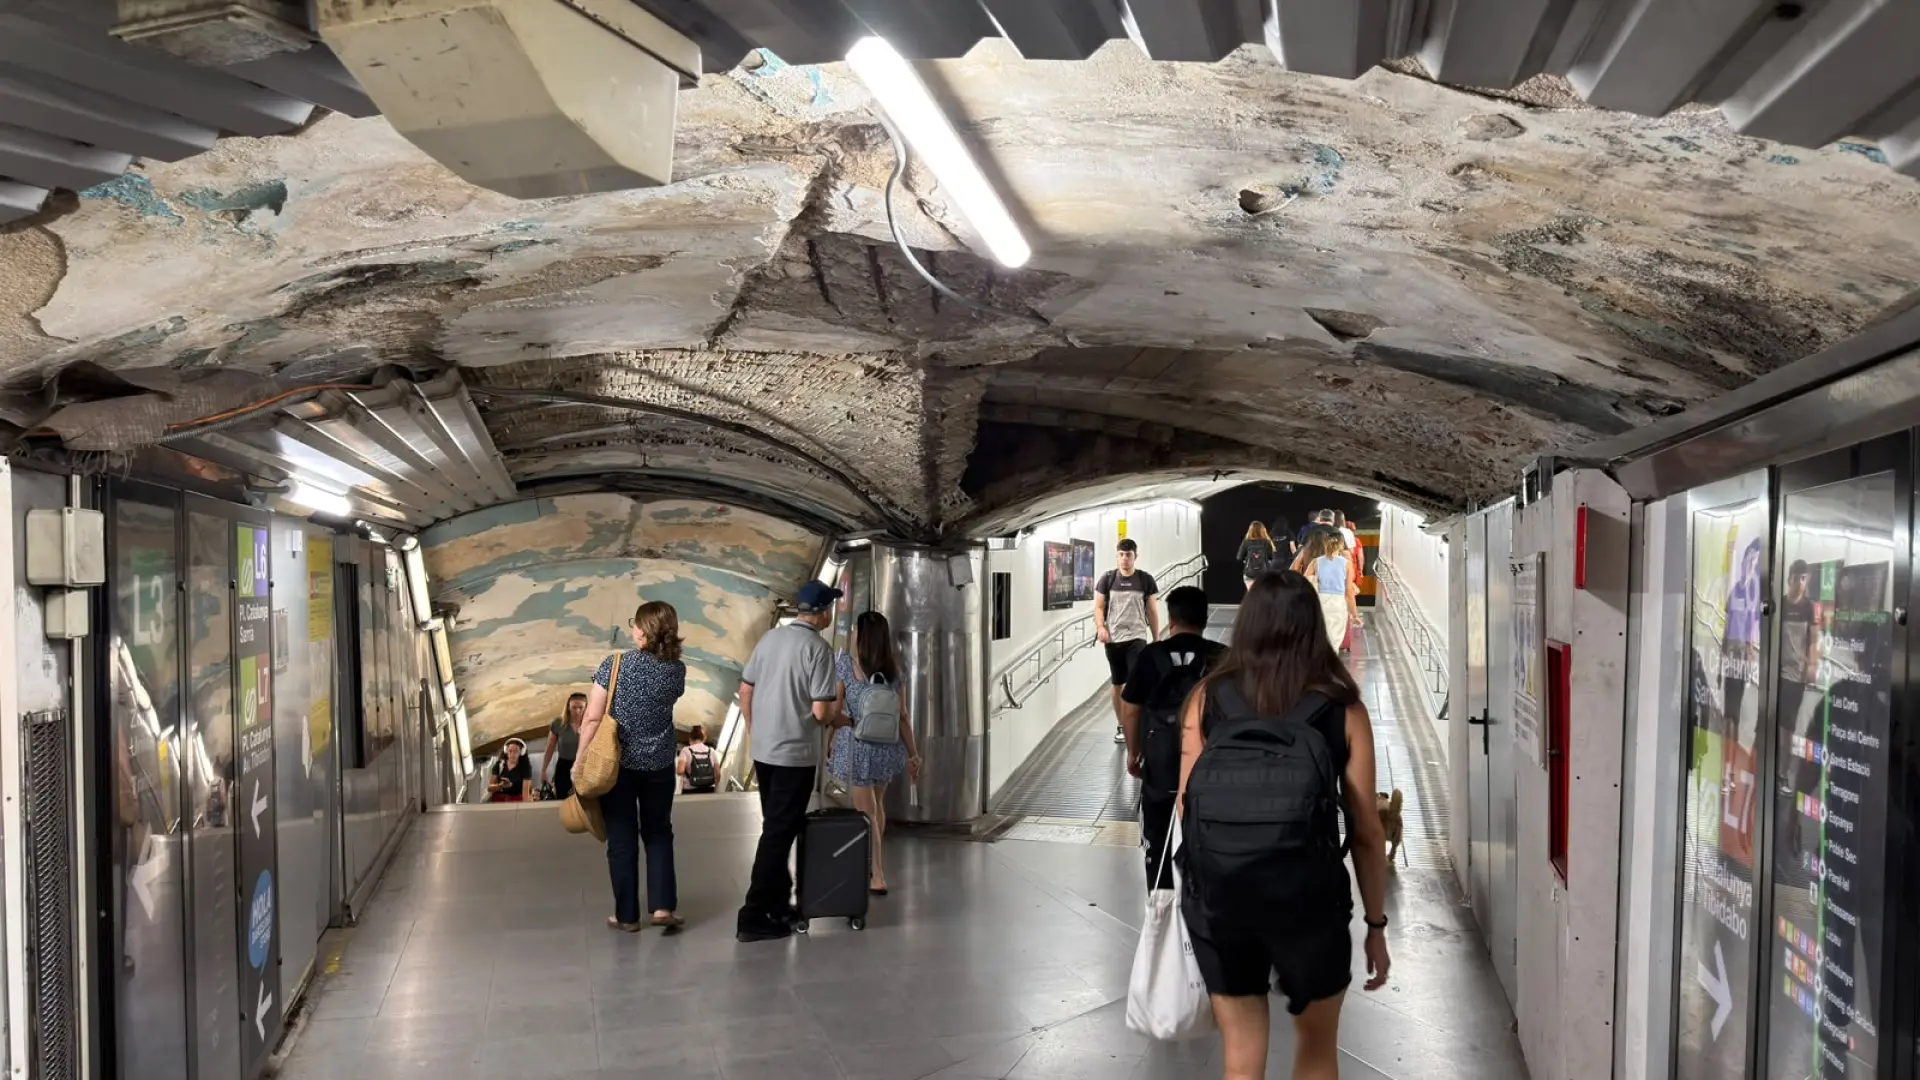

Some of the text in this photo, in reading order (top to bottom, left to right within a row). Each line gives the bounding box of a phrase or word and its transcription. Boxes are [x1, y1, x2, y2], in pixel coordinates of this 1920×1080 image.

[254, 543, 267, 580] L6
[133, 574, 164, 646] L3
[257, 667, 269, 705] L7
[1722, 762, 1755, 835] L7
